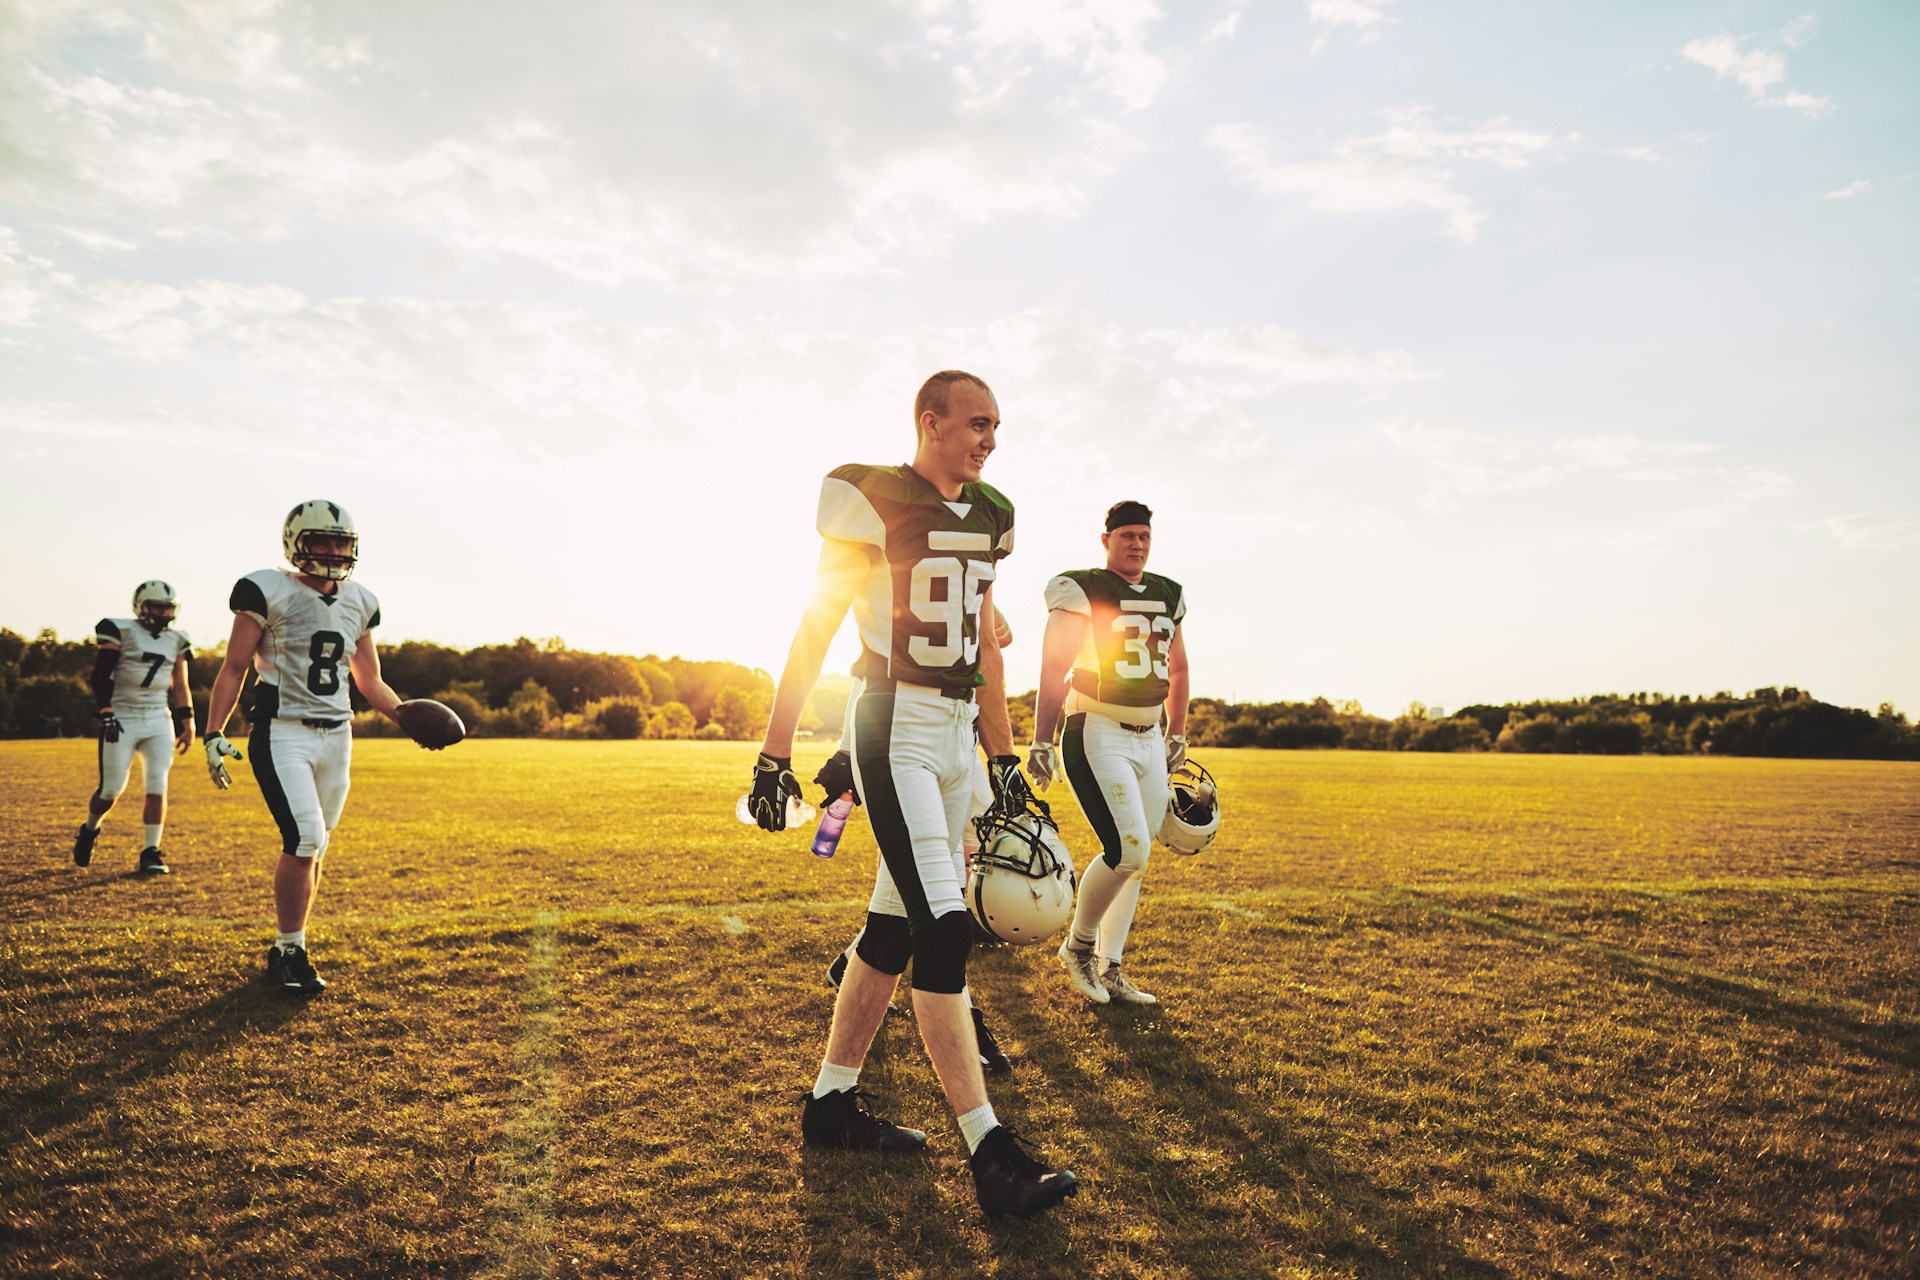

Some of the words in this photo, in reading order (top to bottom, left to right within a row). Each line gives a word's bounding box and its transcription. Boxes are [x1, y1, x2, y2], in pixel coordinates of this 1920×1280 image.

[140, 652, 166, 688] 7
[307, 630, 345, 696] 8
[1111, 614, 1176, 680] 33
